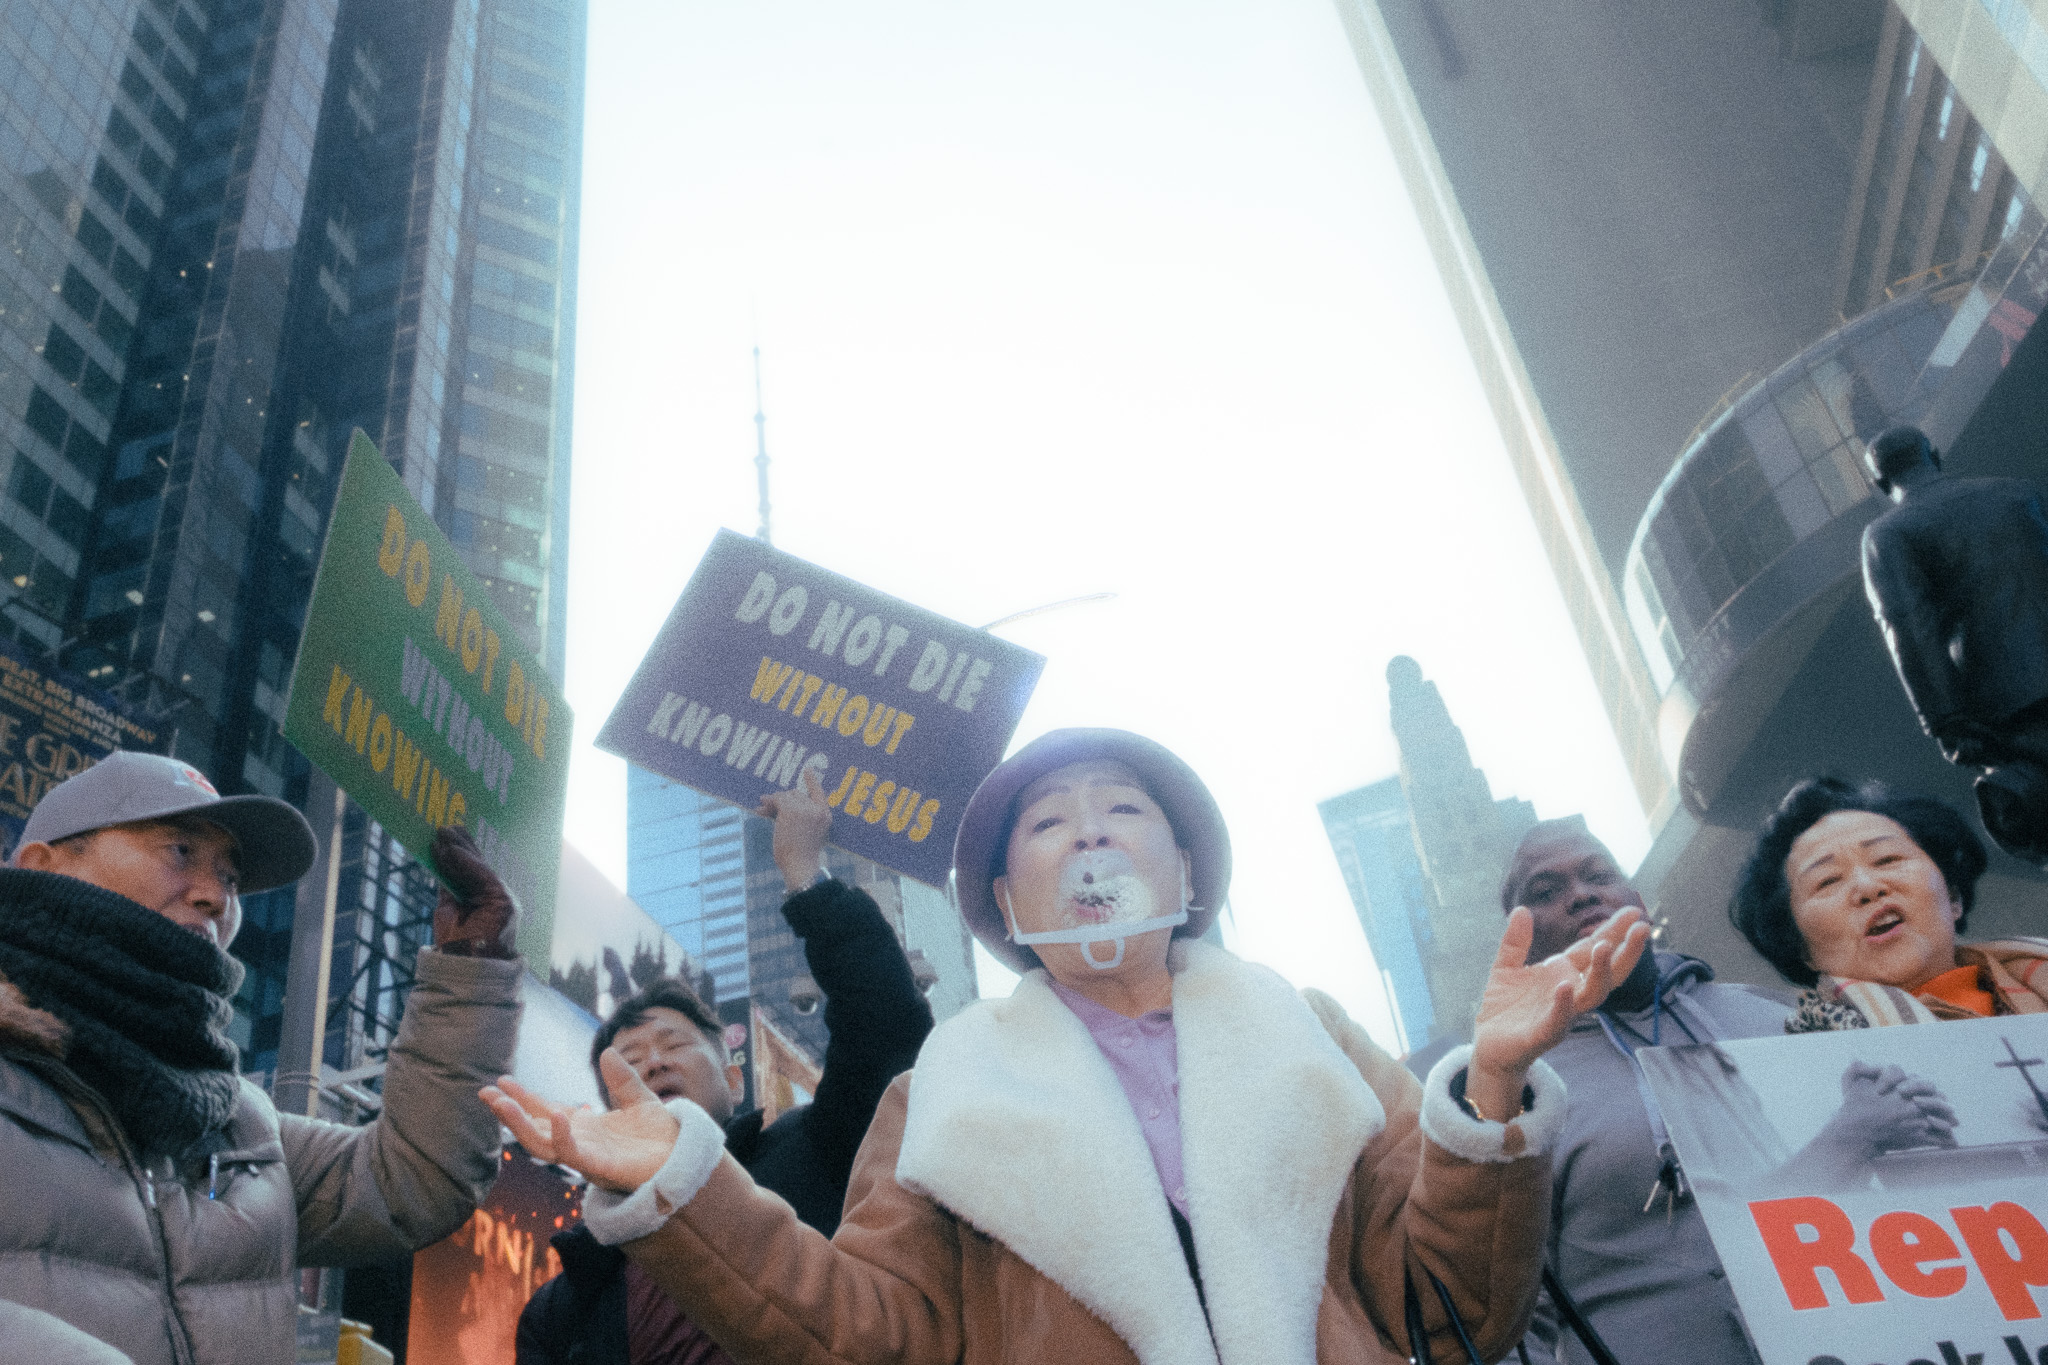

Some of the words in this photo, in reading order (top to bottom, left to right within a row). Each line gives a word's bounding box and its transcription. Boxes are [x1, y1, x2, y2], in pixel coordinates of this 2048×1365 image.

[378, 503, 430, 607] DO
[435, 574, 500, 695] NOT
[504, 660, 549, 760] DIE
[734, 570, 808, 636] DO
[807, 601, 908, 676] NOT
[908, 641, 993, 712] DIE
[3, 673, 121, 744] EXTRAVAGANZA
[45, 680, 72, 702] BIG
[76, 695, 156, 743] BROADWAY
[401, 635, 514, 805] WITHOUT
[646, 691, 829, 794] KNOWING
[828, 766, 940, 843] JESUS
[750, 656, 915, 755] WITHOUT
[1747, 1196, 2048, 1321] Rep
